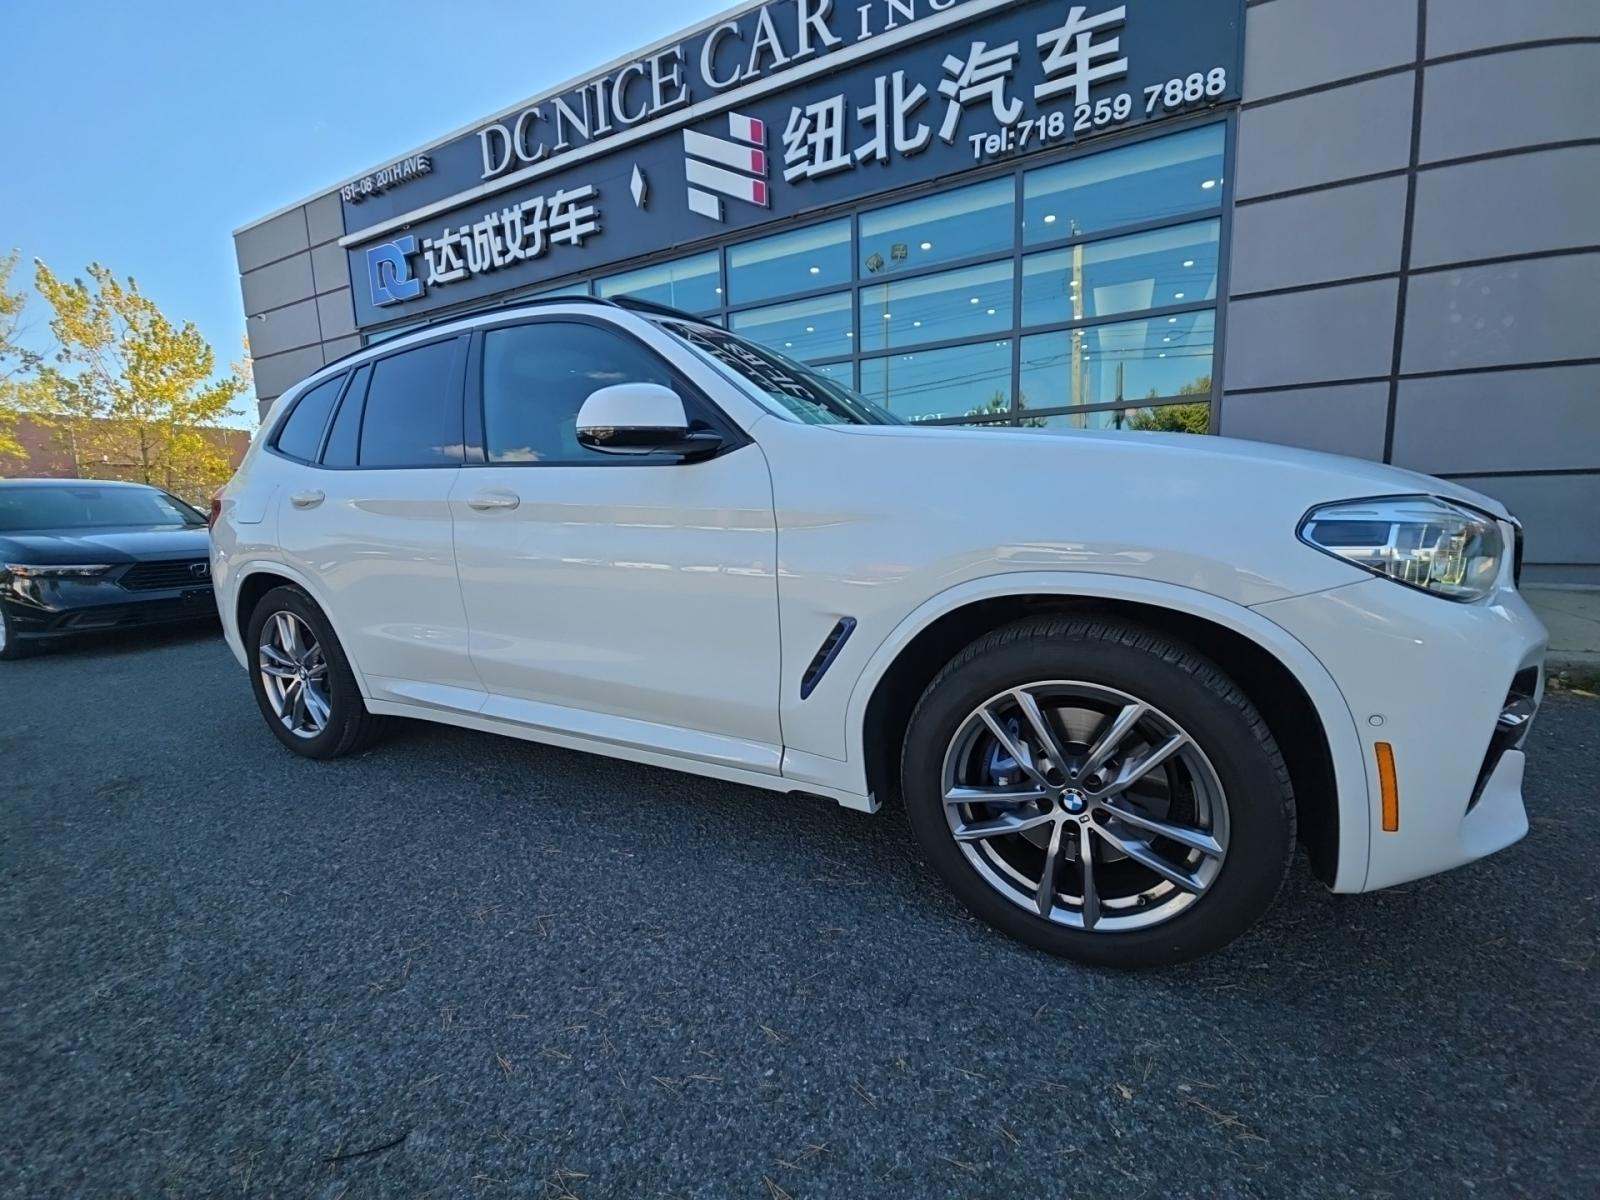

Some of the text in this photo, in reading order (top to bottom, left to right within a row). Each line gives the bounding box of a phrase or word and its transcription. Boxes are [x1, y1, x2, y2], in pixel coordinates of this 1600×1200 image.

[477, 107, 545, 179] DC
[551, 45, 689, 150] NICE
[700, 0, 842, 89] CAR
[782, 6, 1129, 183] 纽北汽车
[1073, 93, 1132, 132] 259
[1144, 67, 1226, 113] 7888
[340, 153, 429, 201] 131-08 20TH AVE
[423, 194, 596, 286] 达诚好车
